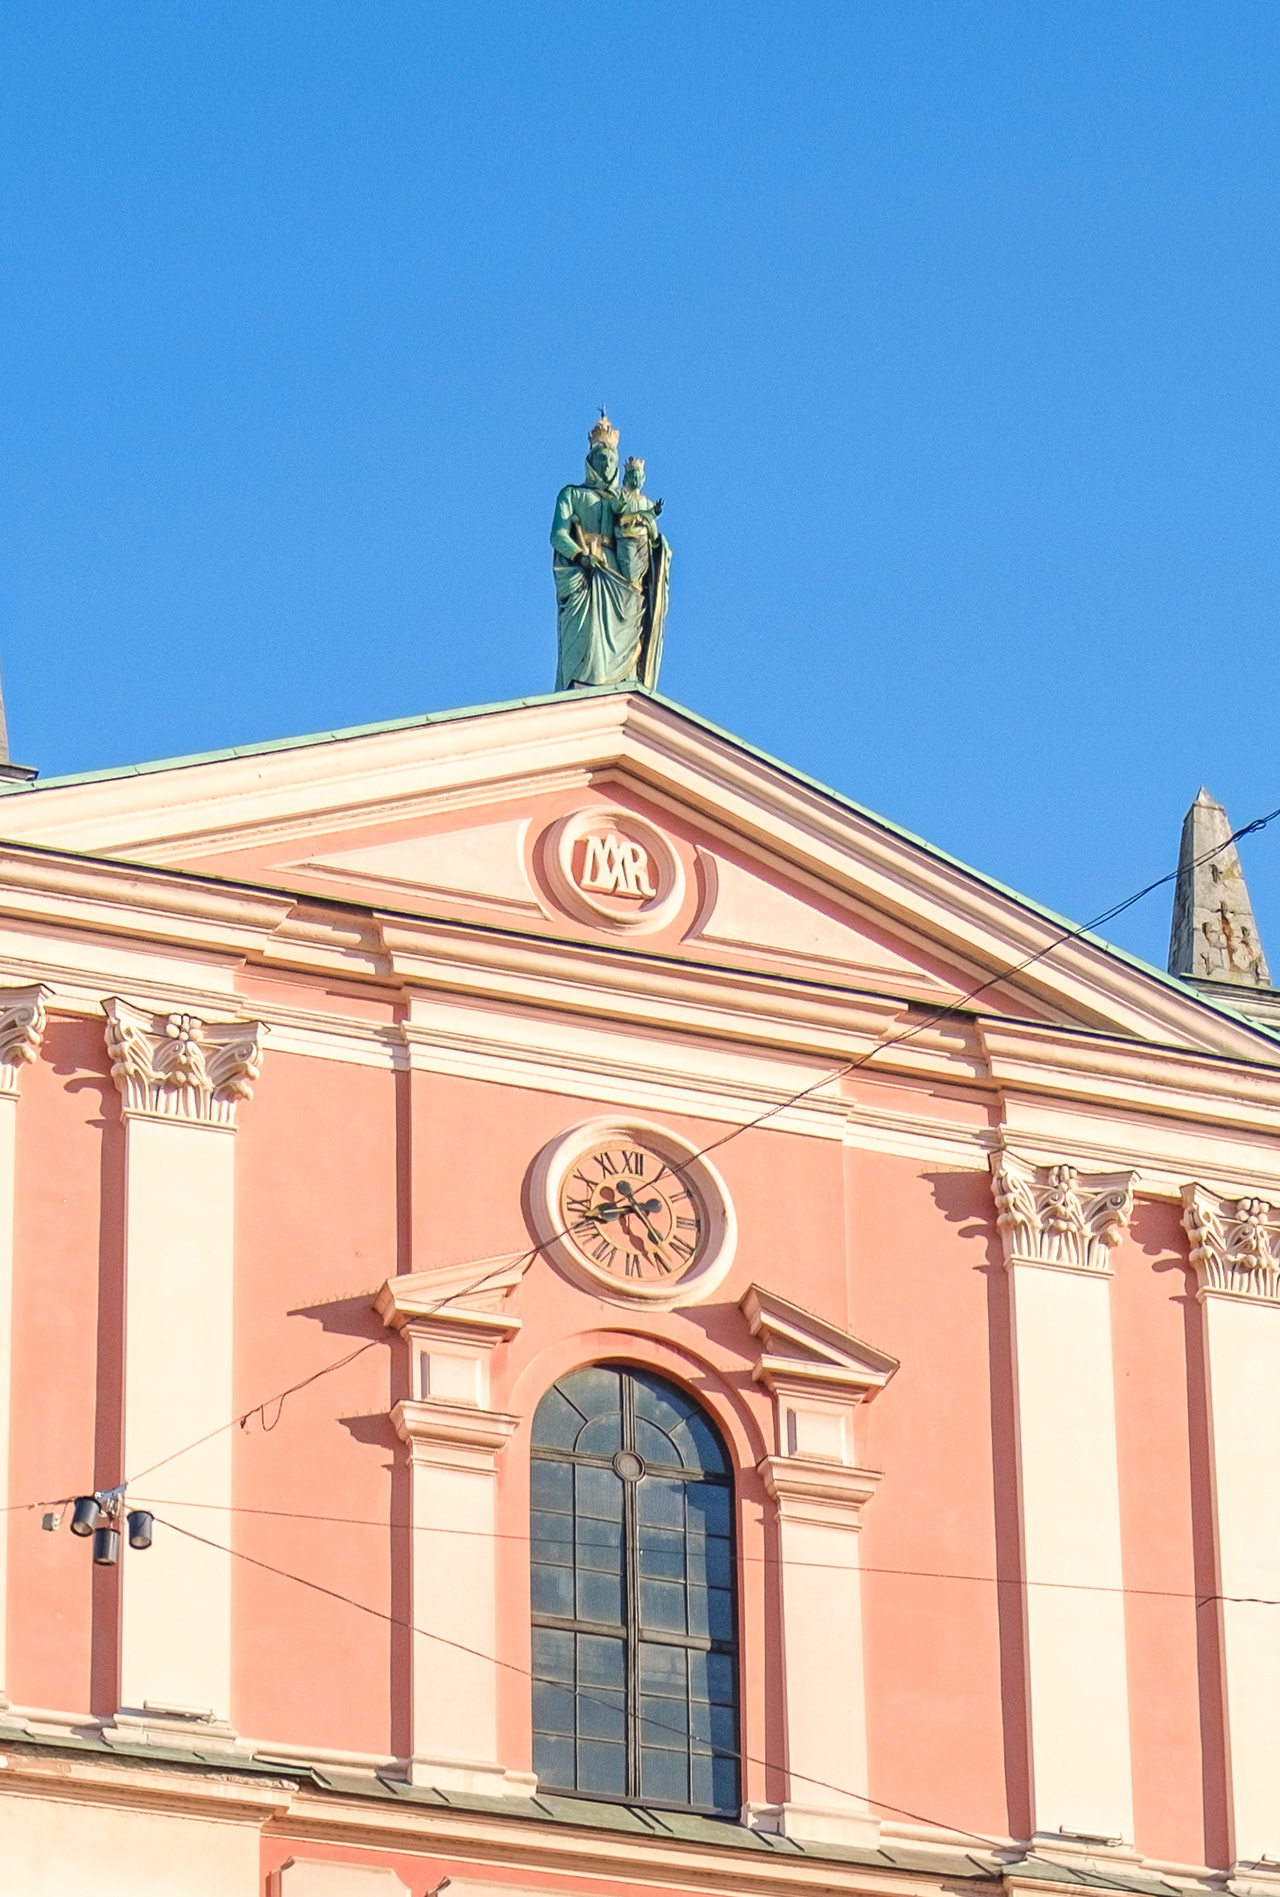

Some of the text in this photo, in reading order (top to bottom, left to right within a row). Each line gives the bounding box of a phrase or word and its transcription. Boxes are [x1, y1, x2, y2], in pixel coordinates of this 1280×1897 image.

[594, 1152, 618, 1178] XI
[622, 1151, 643, 1176] XII
[573, 1168, 598, 1191] X
